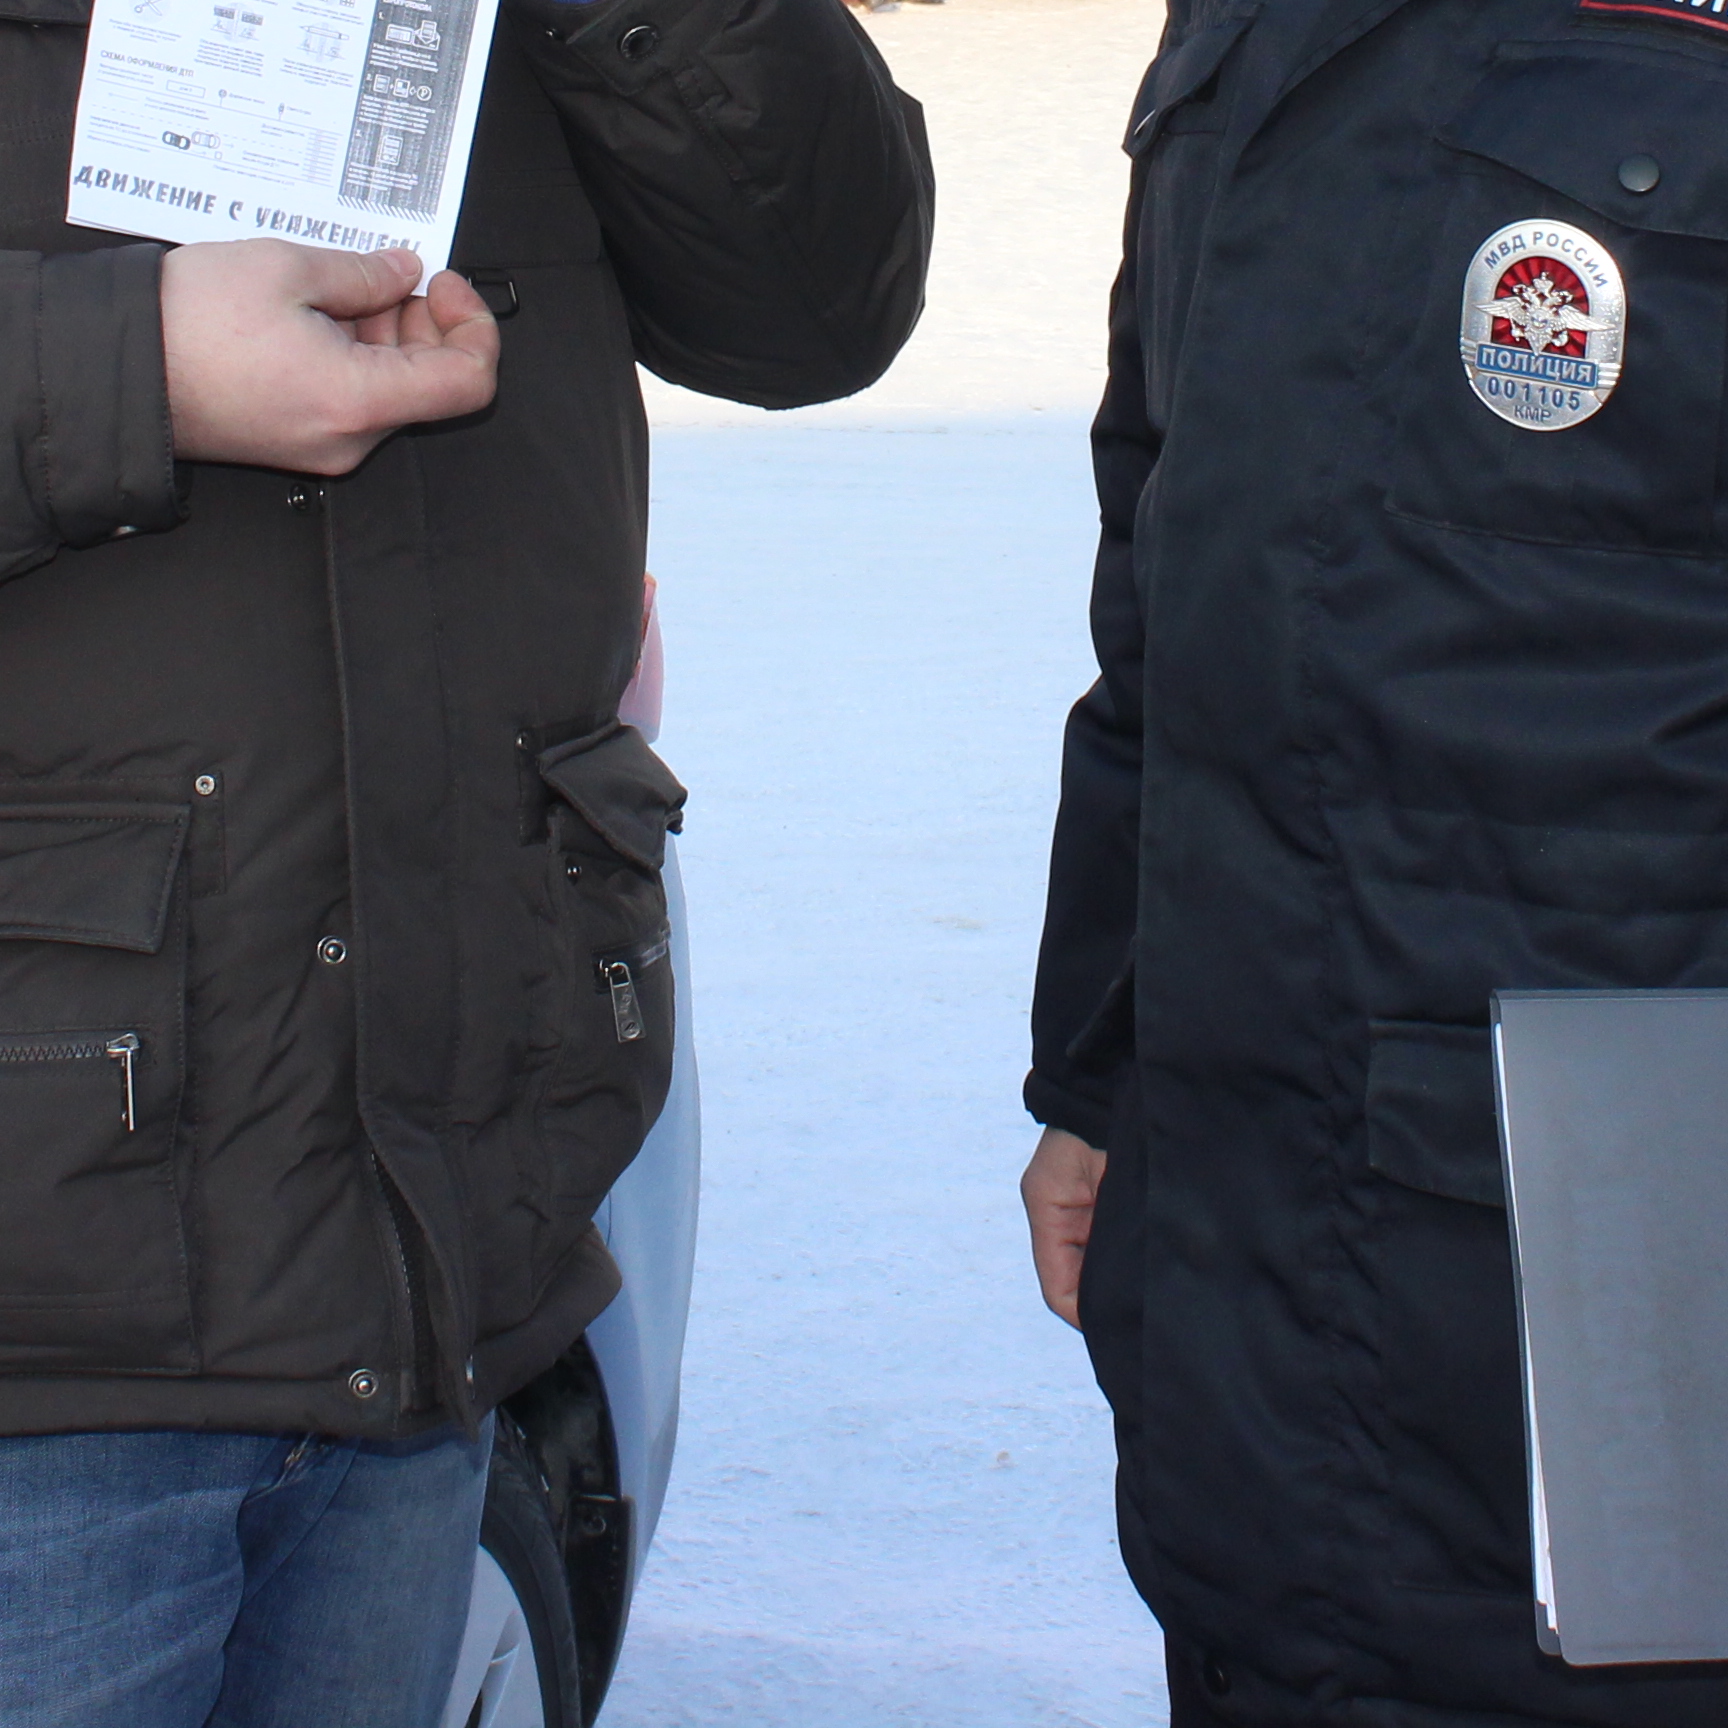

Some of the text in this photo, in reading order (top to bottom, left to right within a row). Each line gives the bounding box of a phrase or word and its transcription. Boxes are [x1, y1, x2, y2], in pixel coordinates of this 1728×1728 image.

[101, 49, 126, 63] СХЕМА
[127, 57, 178, 75] ОФОРМЛЕНИЯ
[178, 66, 194, 78] ДТП
[73, 165, 217, 214] ДВИЖЕНИЕ
[229, 200, 244, 221] С
[1484, 231, 1609, 289] МВД РОССИИ
[1481, 346, 1593, 385] ПОЛИЦИЯ
[1487, 376, 1581, 411] 001105
[1514, 404, 1553, 423] КМР
